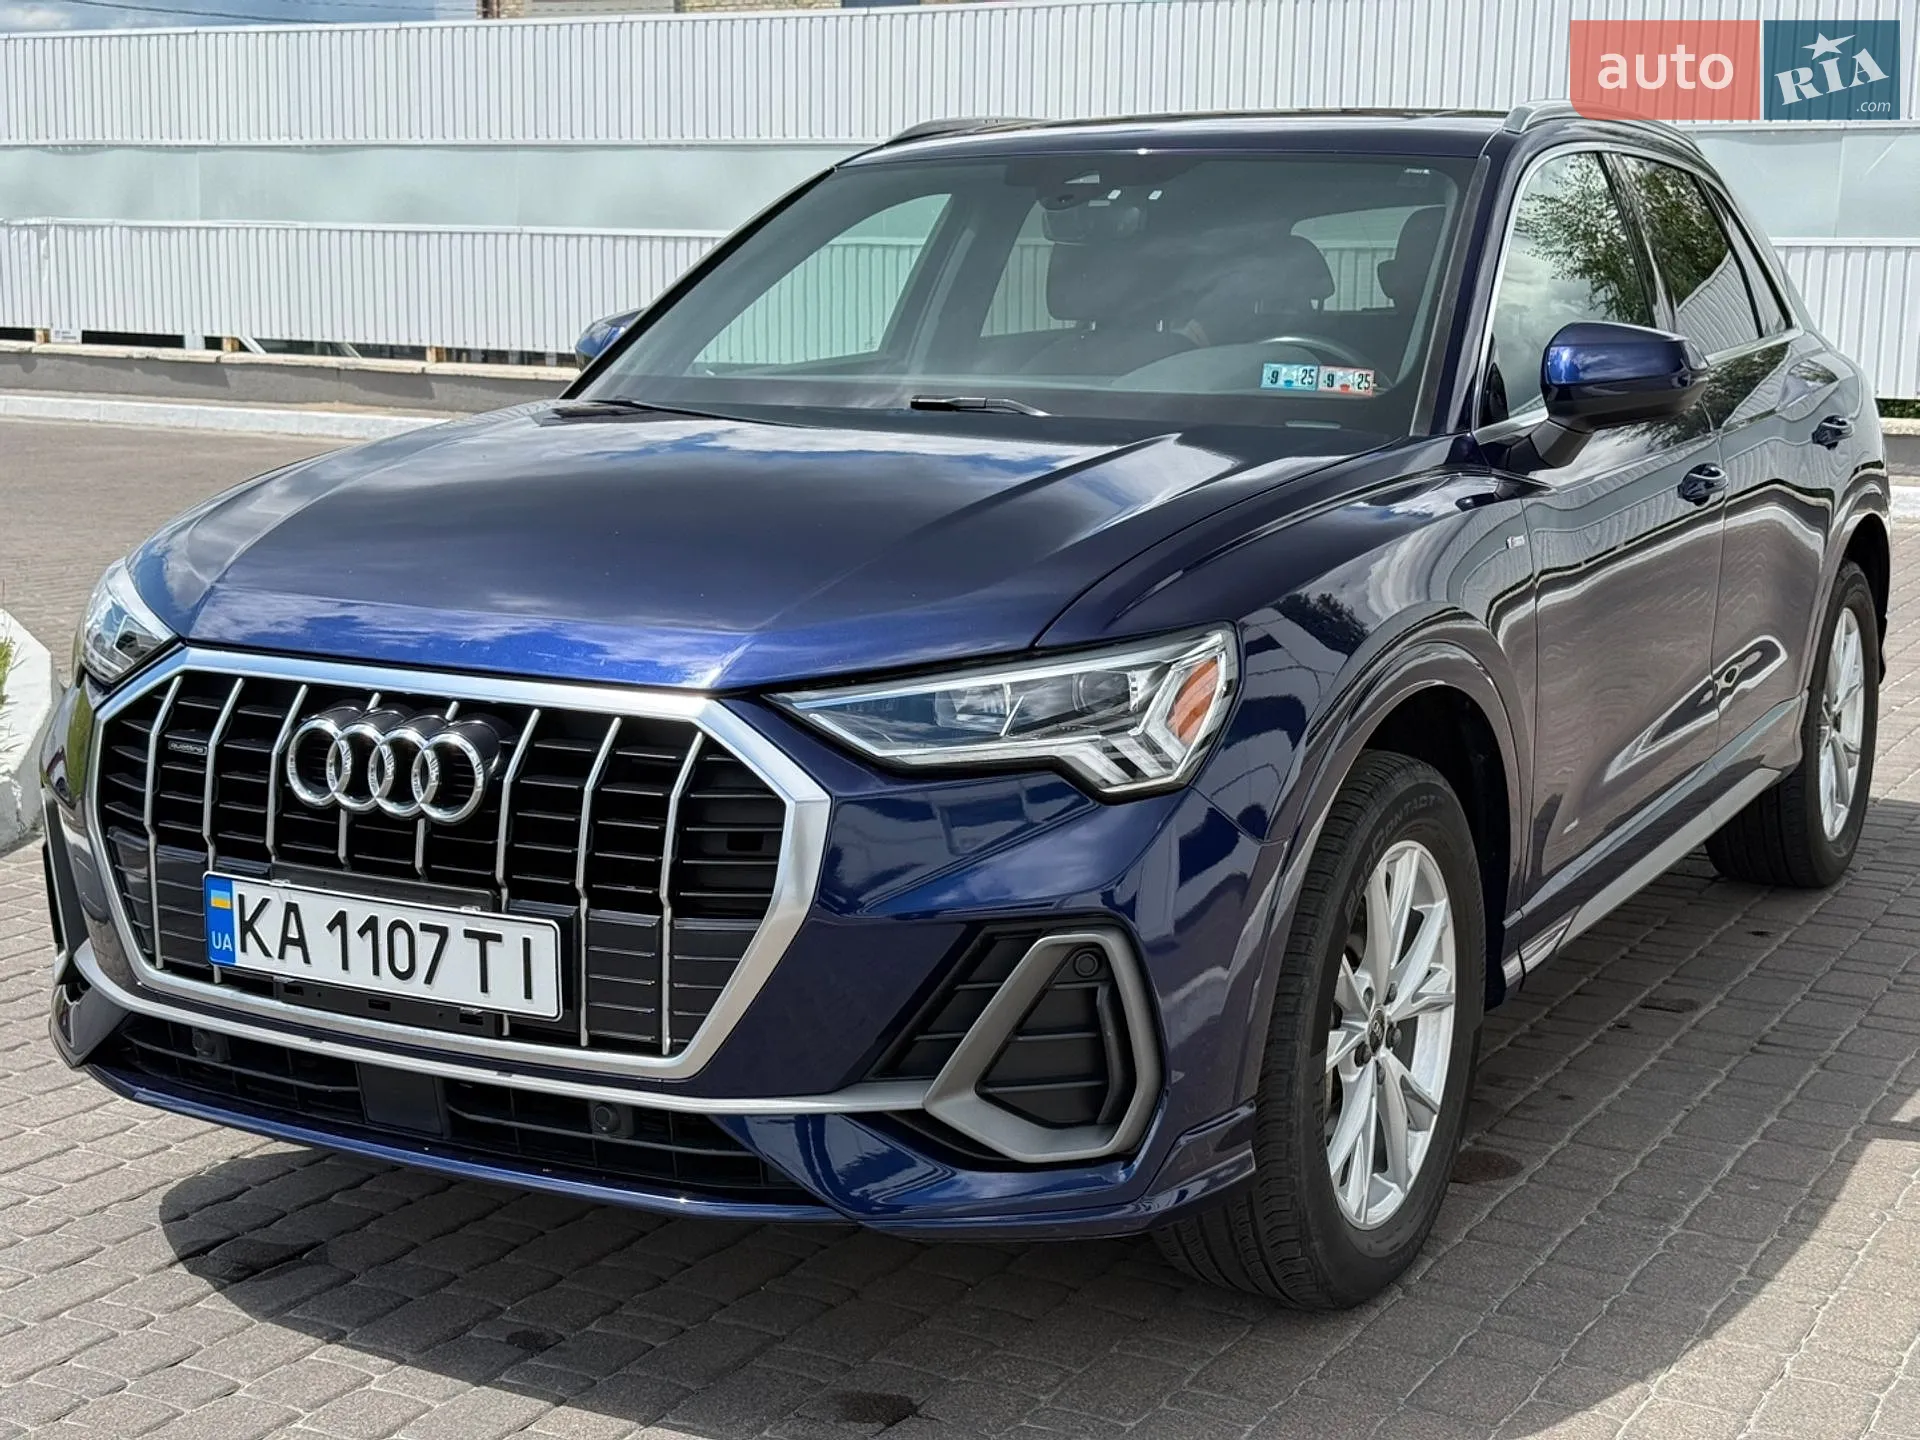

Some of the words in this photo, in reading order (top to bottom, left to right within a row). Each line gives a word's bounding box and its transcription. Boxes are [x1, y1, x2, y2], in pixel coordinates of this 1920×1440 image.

[1301, 368, 1315, 386] 25
[1357, 373, 1371, 391] 25
[212, 931, 233, 952] UA
[237, 893, 312, 965] KA
[326, 909, 450, 986] 1107
[463, 929, 534, 1000] TI
